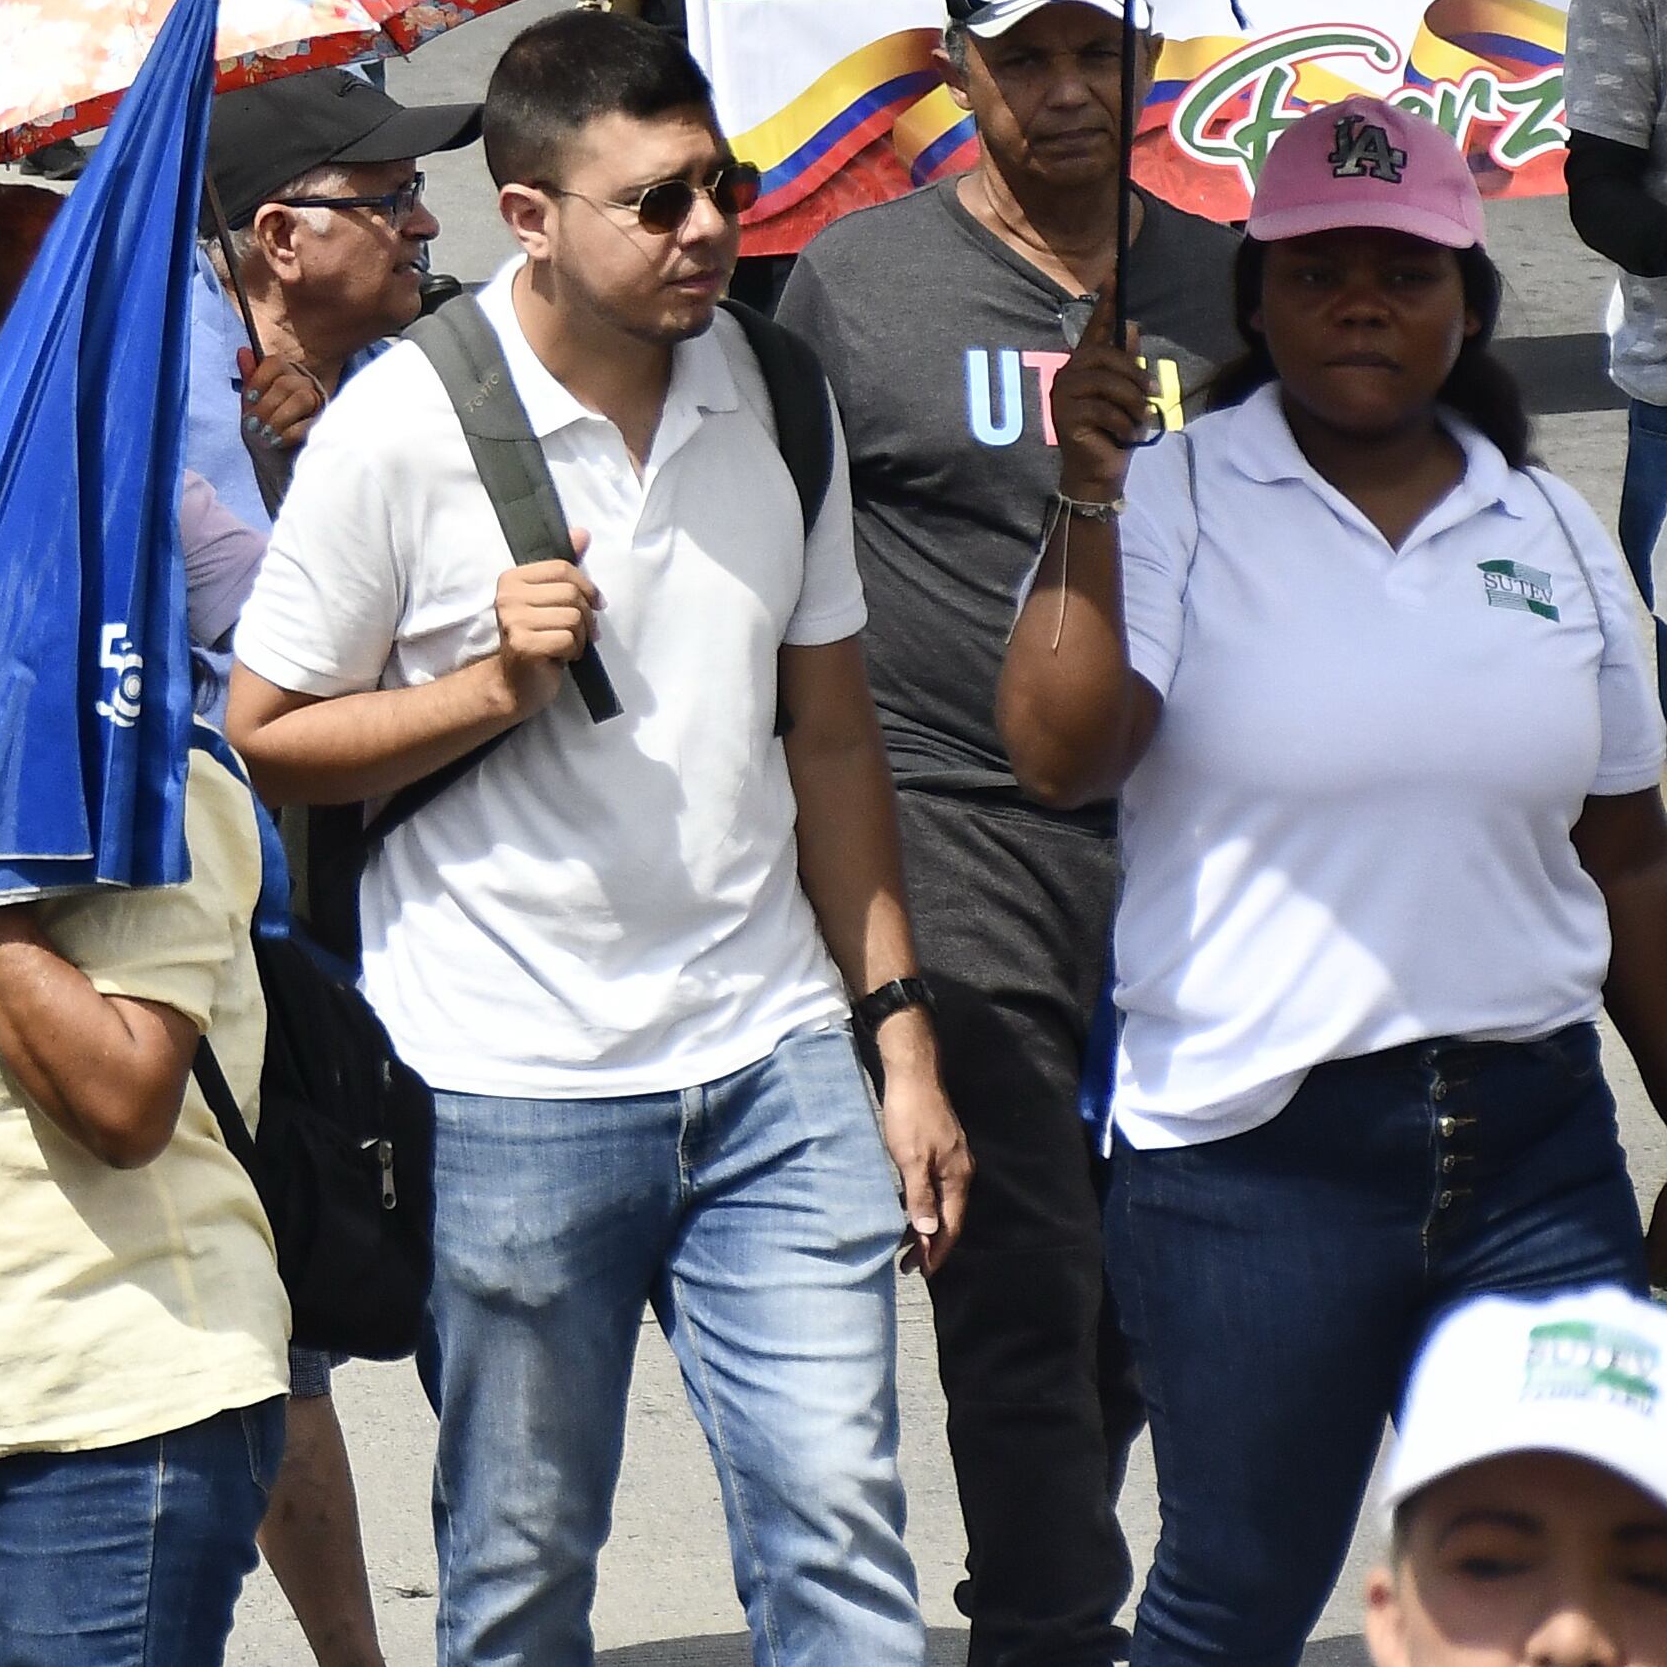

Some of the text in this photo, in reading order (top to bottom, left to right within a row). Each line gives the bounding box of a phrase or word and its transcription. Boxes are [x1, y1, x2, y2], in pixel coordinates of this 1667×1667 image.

[1328, 115, 1407, 183] LA
[966, 349, 1185, 447] UTH
[1482, 572, 1553, 604] SUTEV
